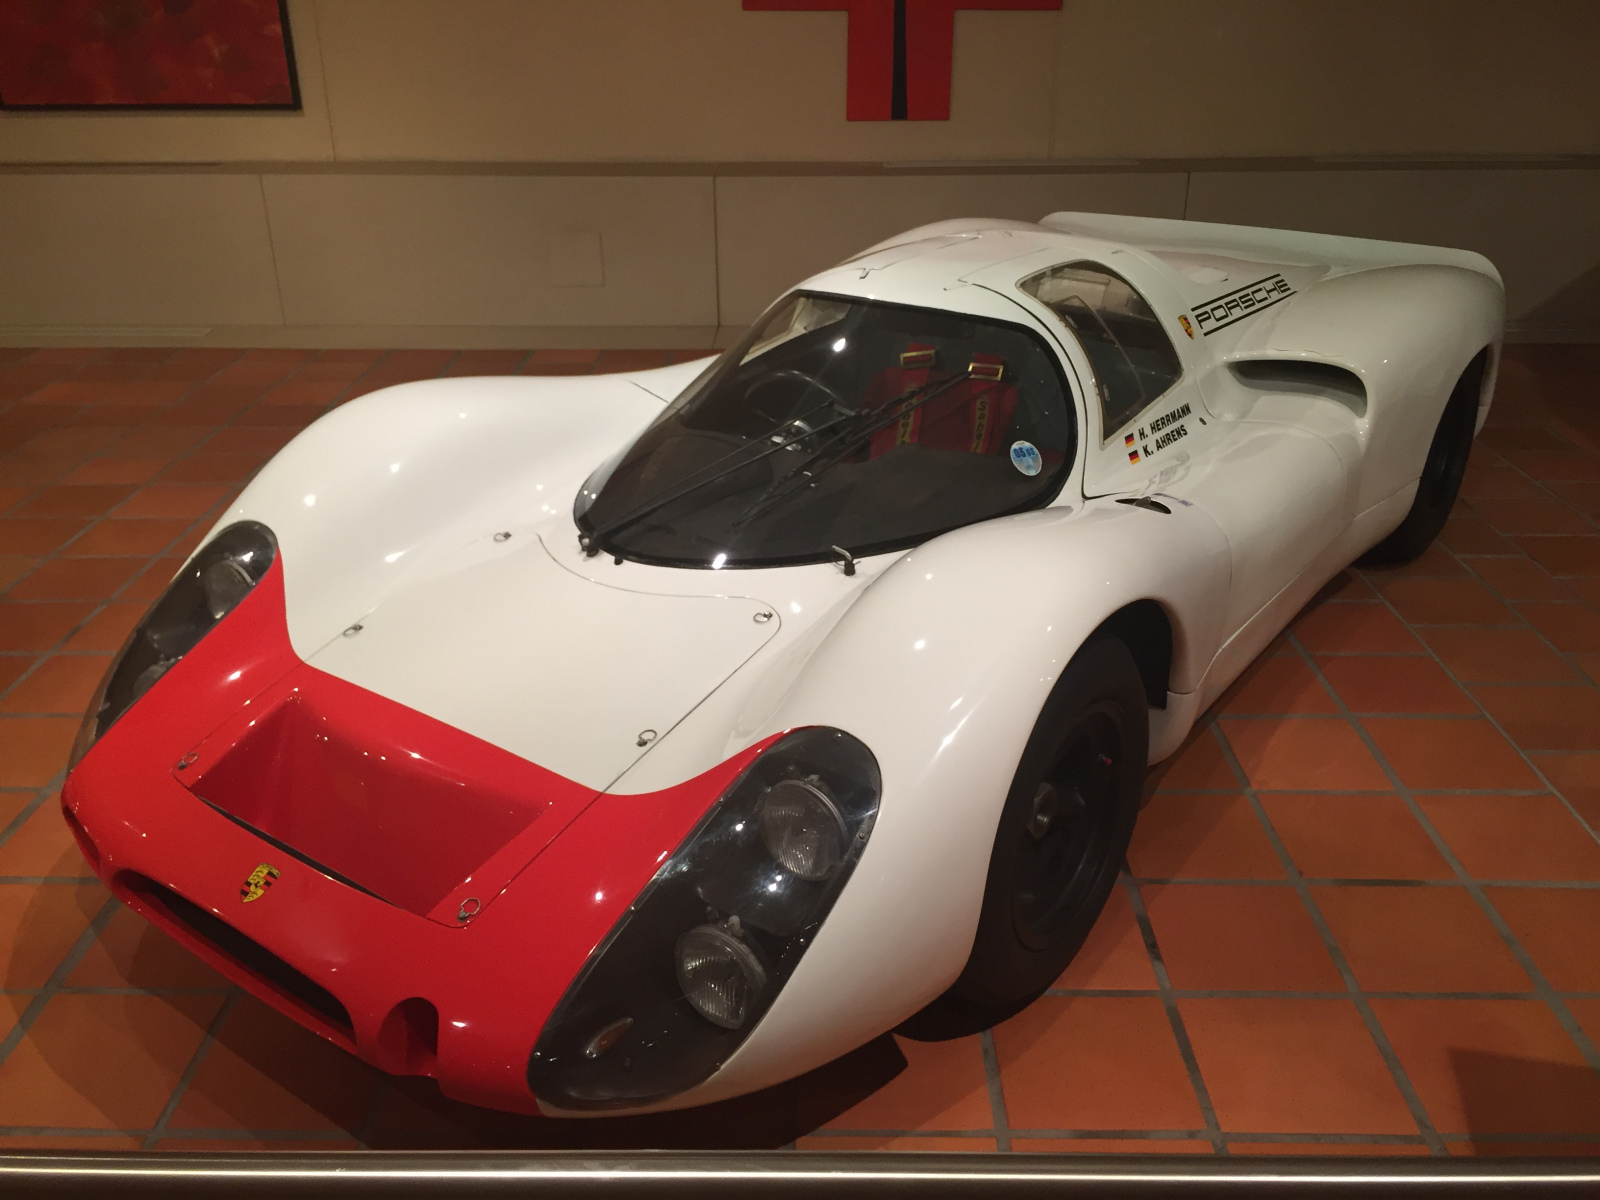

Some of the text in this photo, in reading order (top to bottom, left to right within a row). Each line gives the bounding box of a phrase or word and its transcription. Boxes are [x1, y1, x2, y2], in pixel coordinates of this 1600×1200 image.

[1195, 279, 1291, 329] PORSCHE
[973, 400, 988, 452] Sabel
[1138, 403, 1191, 441] H. HERRMANN
[1142, 424, 1188, 457] K. AHRENS
[1013, 447, 1026, 458] 05
